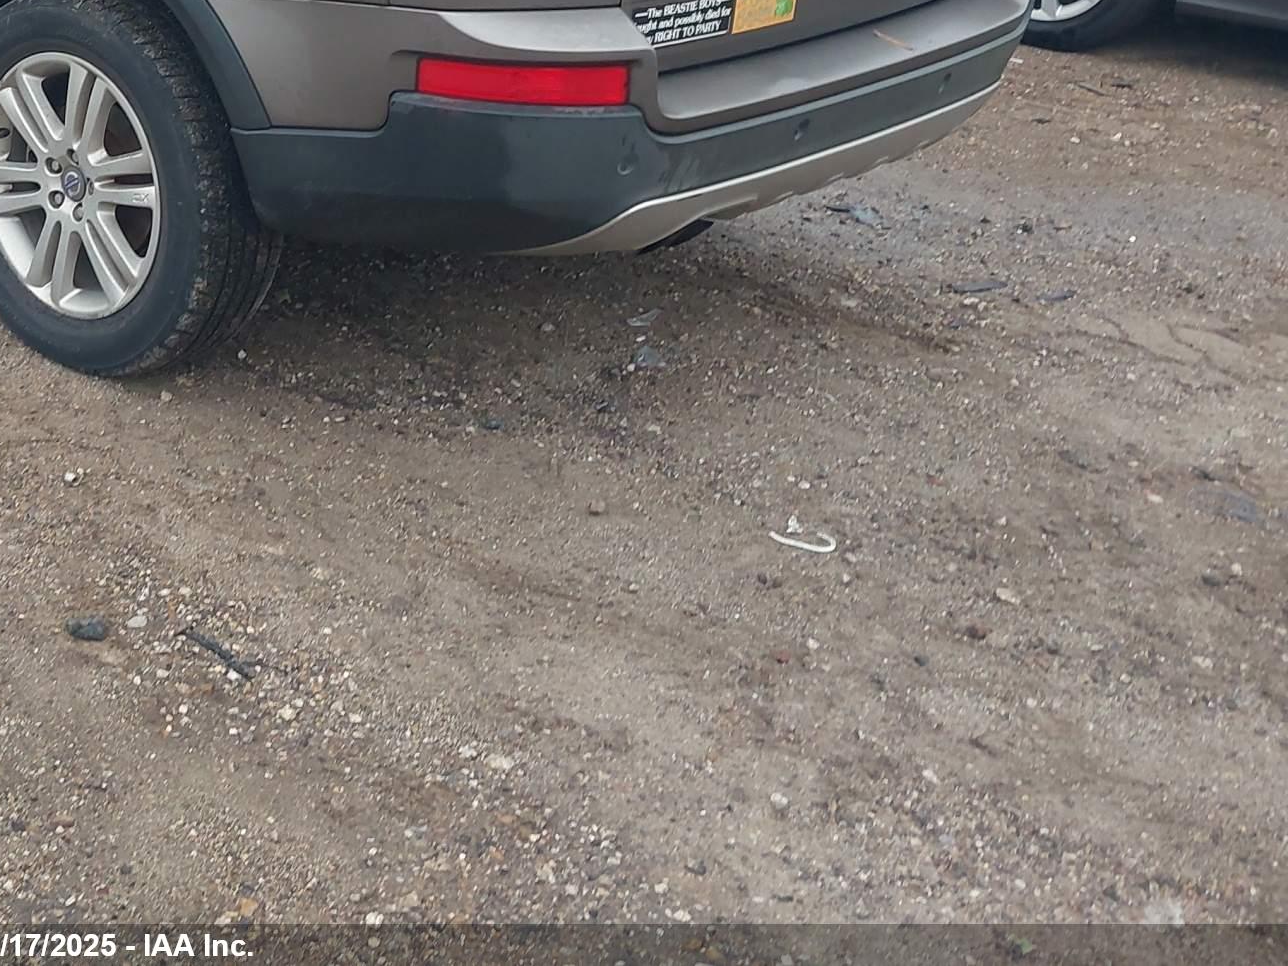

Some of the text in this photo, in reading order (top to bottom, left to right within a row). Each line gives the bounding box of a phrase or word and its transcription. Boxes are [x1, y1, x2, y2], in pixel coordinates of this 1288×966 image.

[647, 7, 663, 19] The
[663, 0, 699, 16] BEASTIE
[658, 15, 675, 30] and
[674, 11, 705, 29] possibly
[705, 7, 721, 21] died
[720, 5, 732, 19] for
[654, 28, 683, 43] RIGHT
[682, 25, 694, 38] TO
[694, 19, 722, 36] PARTY
